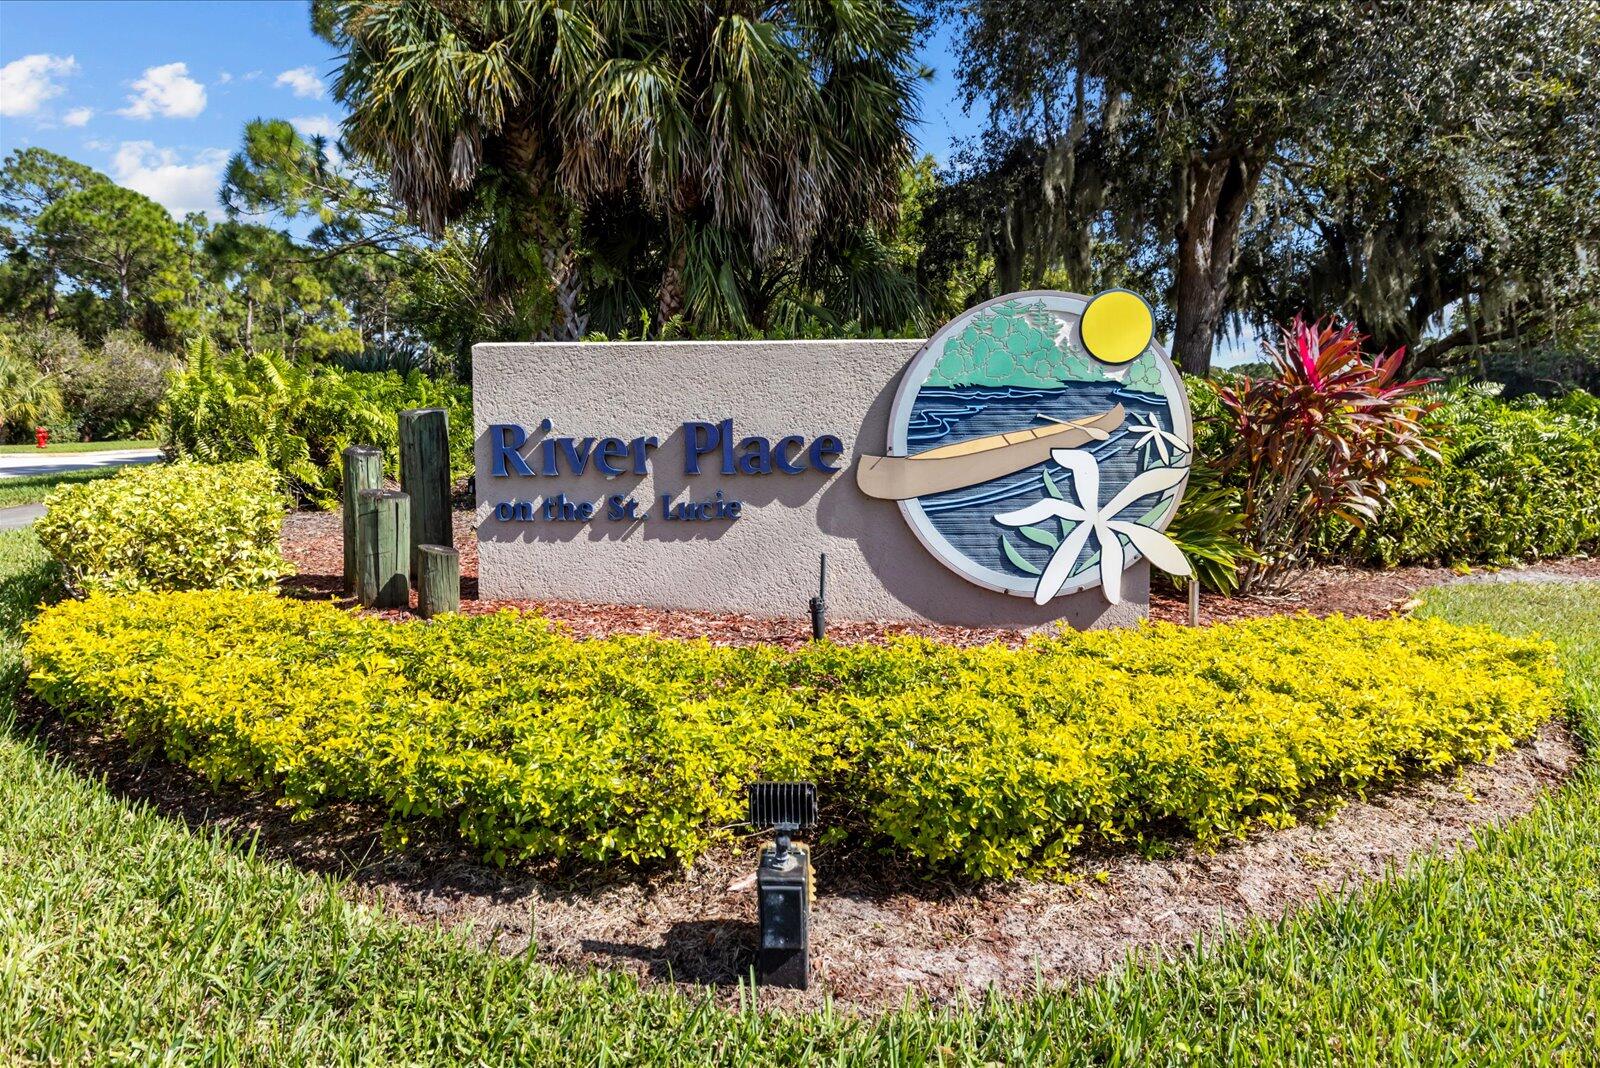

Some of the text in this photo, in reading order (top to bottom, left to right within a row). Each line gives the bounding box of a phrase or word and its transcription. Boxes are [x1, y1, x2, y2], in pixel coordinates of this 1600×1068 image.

[489, 418, 844, 478] River Place
[495, 490, 744, 522] on the St. Lucie
